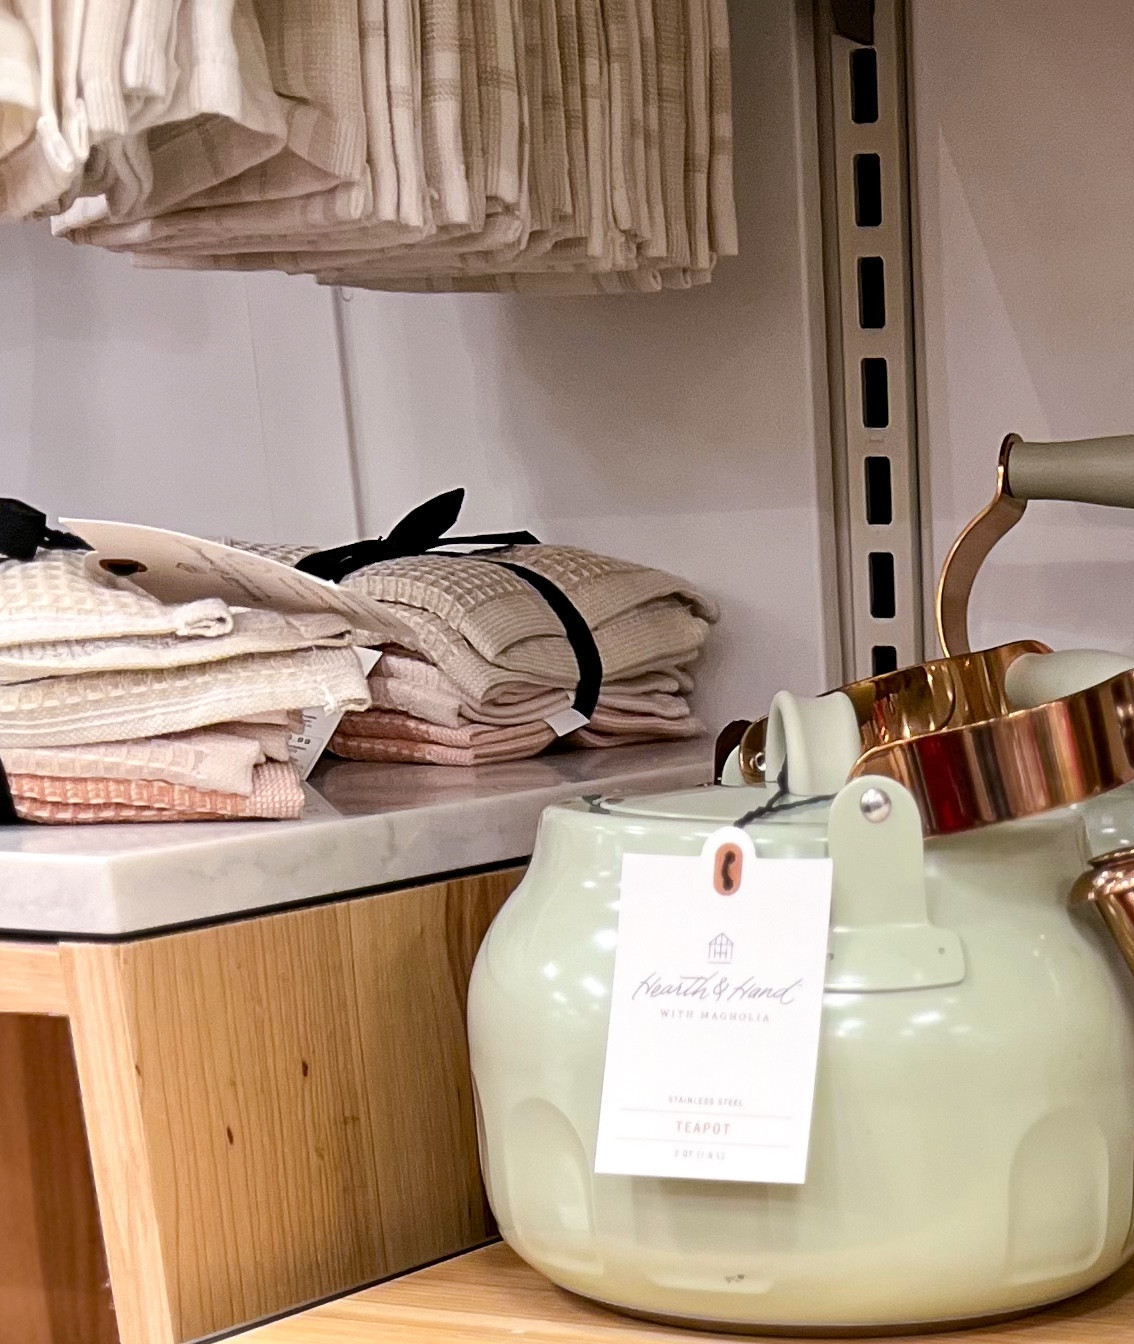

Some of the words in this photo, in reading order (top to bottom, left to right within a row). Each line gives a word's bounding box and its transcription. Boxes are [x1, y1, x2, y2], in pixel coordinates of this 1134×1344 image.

[632, 971, 718, 1000] Hearth
[712, 976, 730, 1001] &
[727, 976, 803, 1005] Hand
[660, 1008, 694, 1018] WITH
[700, 1010, 770, 1022] MAGNOLIA
[668, 1095, 714, 1106] STAINLESS
[717, 1097, 744, 1107] STEEL
[676, 1120, 731, 1136] TEAPOT
